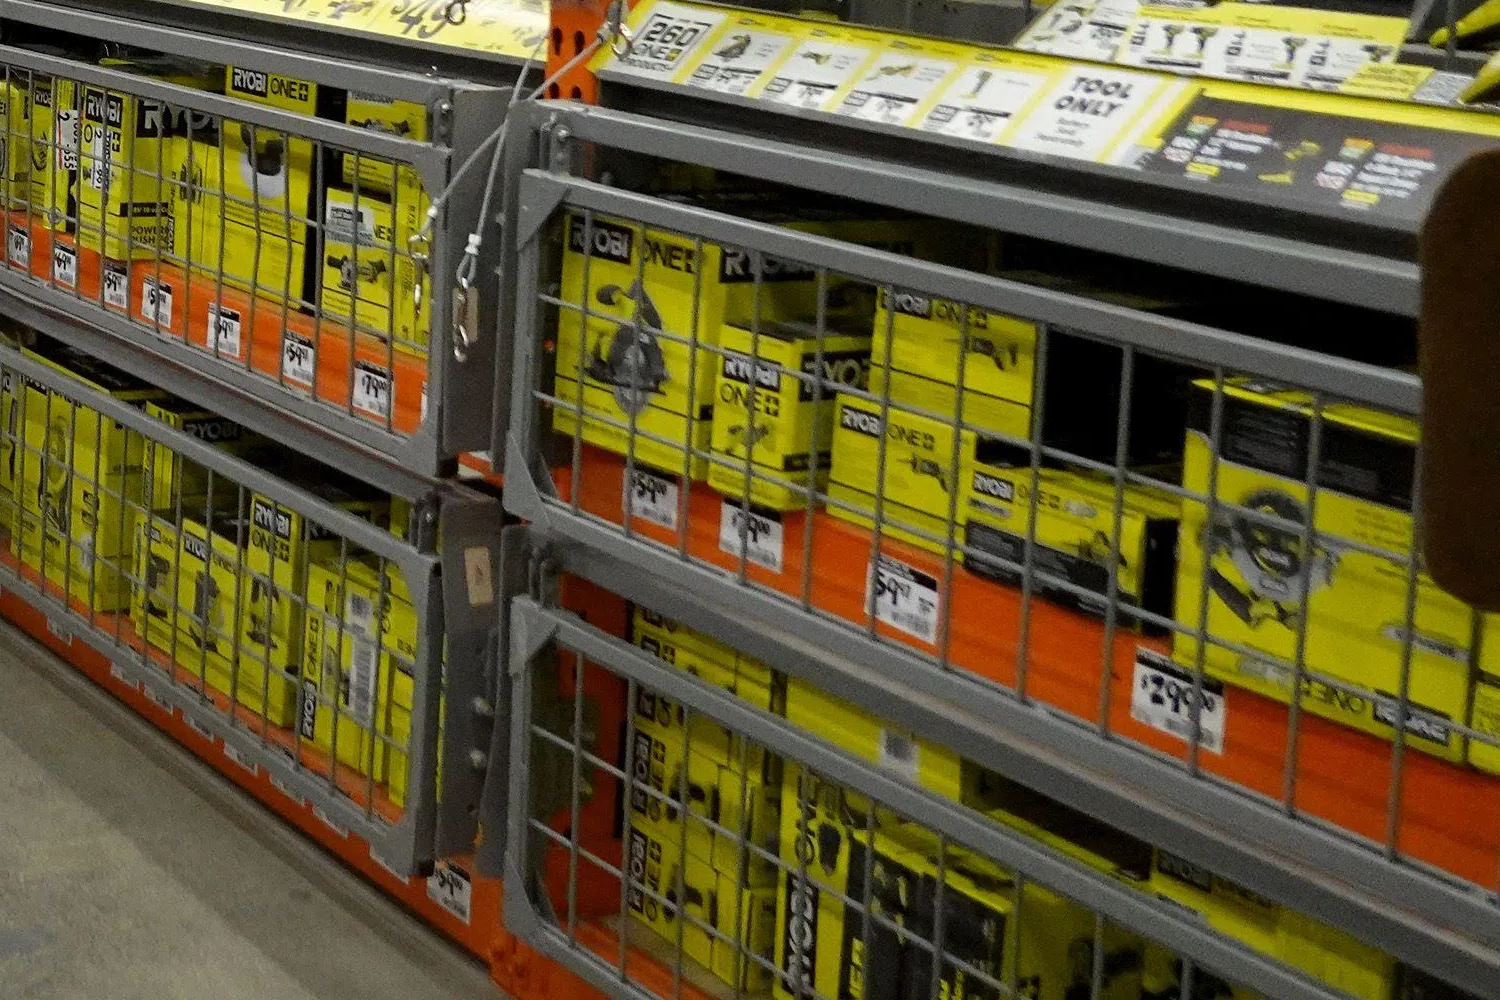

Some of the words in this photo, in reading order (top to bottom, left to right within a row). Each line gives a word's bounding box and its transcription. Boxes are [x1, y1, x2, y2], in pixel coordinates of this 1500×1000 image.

[648, 22, 700, 47] 260
[233, 66, 267, 93] RYOBI
[1071, 75, 1135, 99] TOOL
[87, 94, 121, 124] RYBI
[1054, 95, 1124, 118] ONLY
[571, 222, 630, 258] ROBI
[254, 502, 291, 538] RYBI
